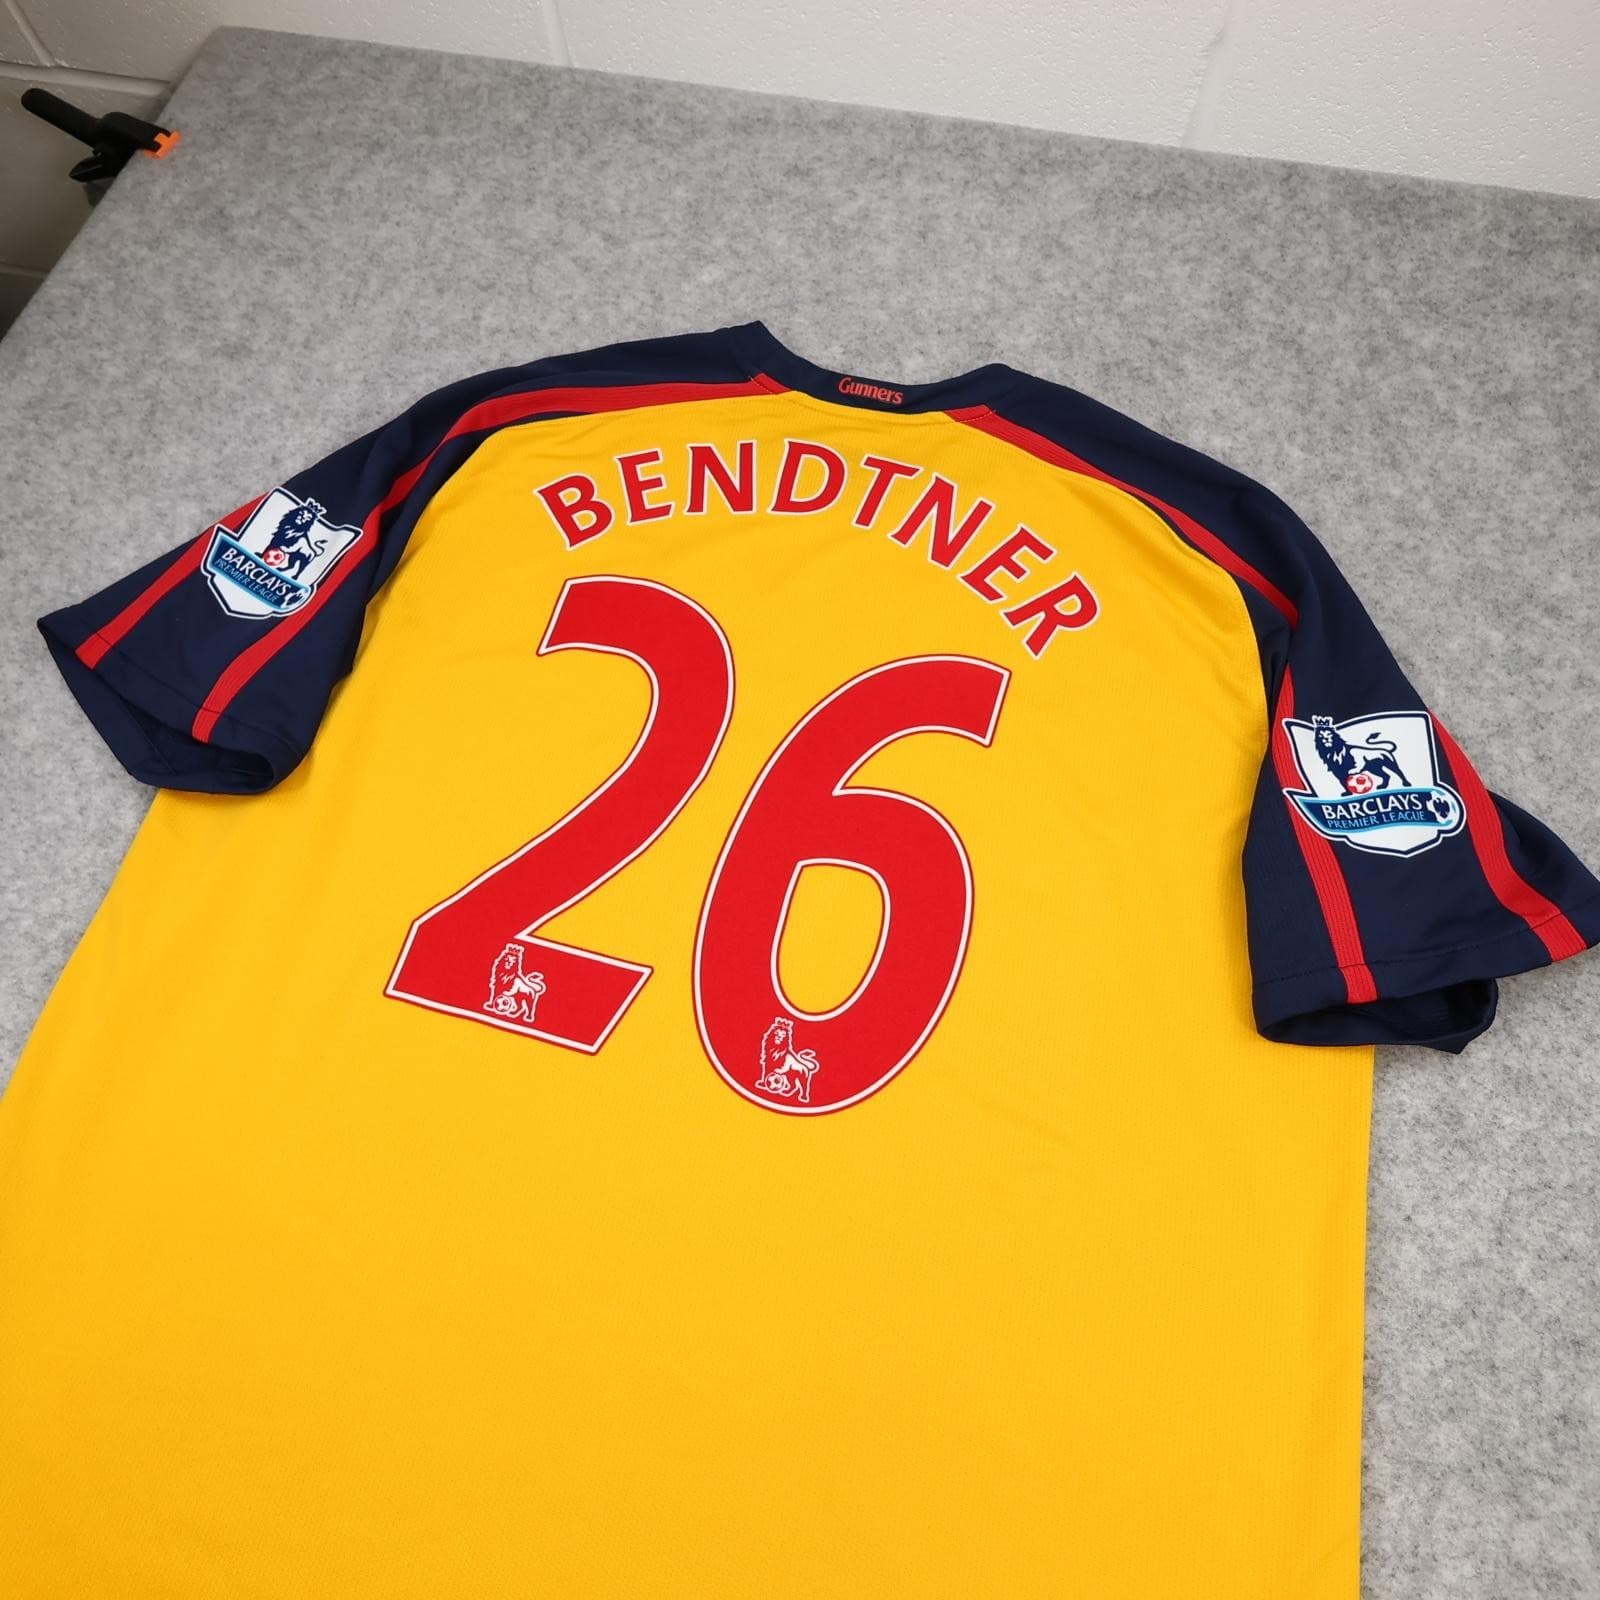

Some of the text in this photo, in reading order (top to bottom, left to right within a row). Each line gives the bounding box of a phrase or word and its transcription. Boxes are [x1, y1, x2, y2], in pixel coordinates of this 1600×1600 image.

[838, 376, 904, 405] Gunners
[537, 440, 1100, 658] BENDTNER
[214, 559, 279, 602] PREMIER LEAGUE
[222, 548, 291, 596] BARCLAYS
[1322, 794, 1422, 819] BARCLAYS
[1327, 810, 1426, 829] PREMIER LEAGUE
[384, 574, 1012, 1117] 26
